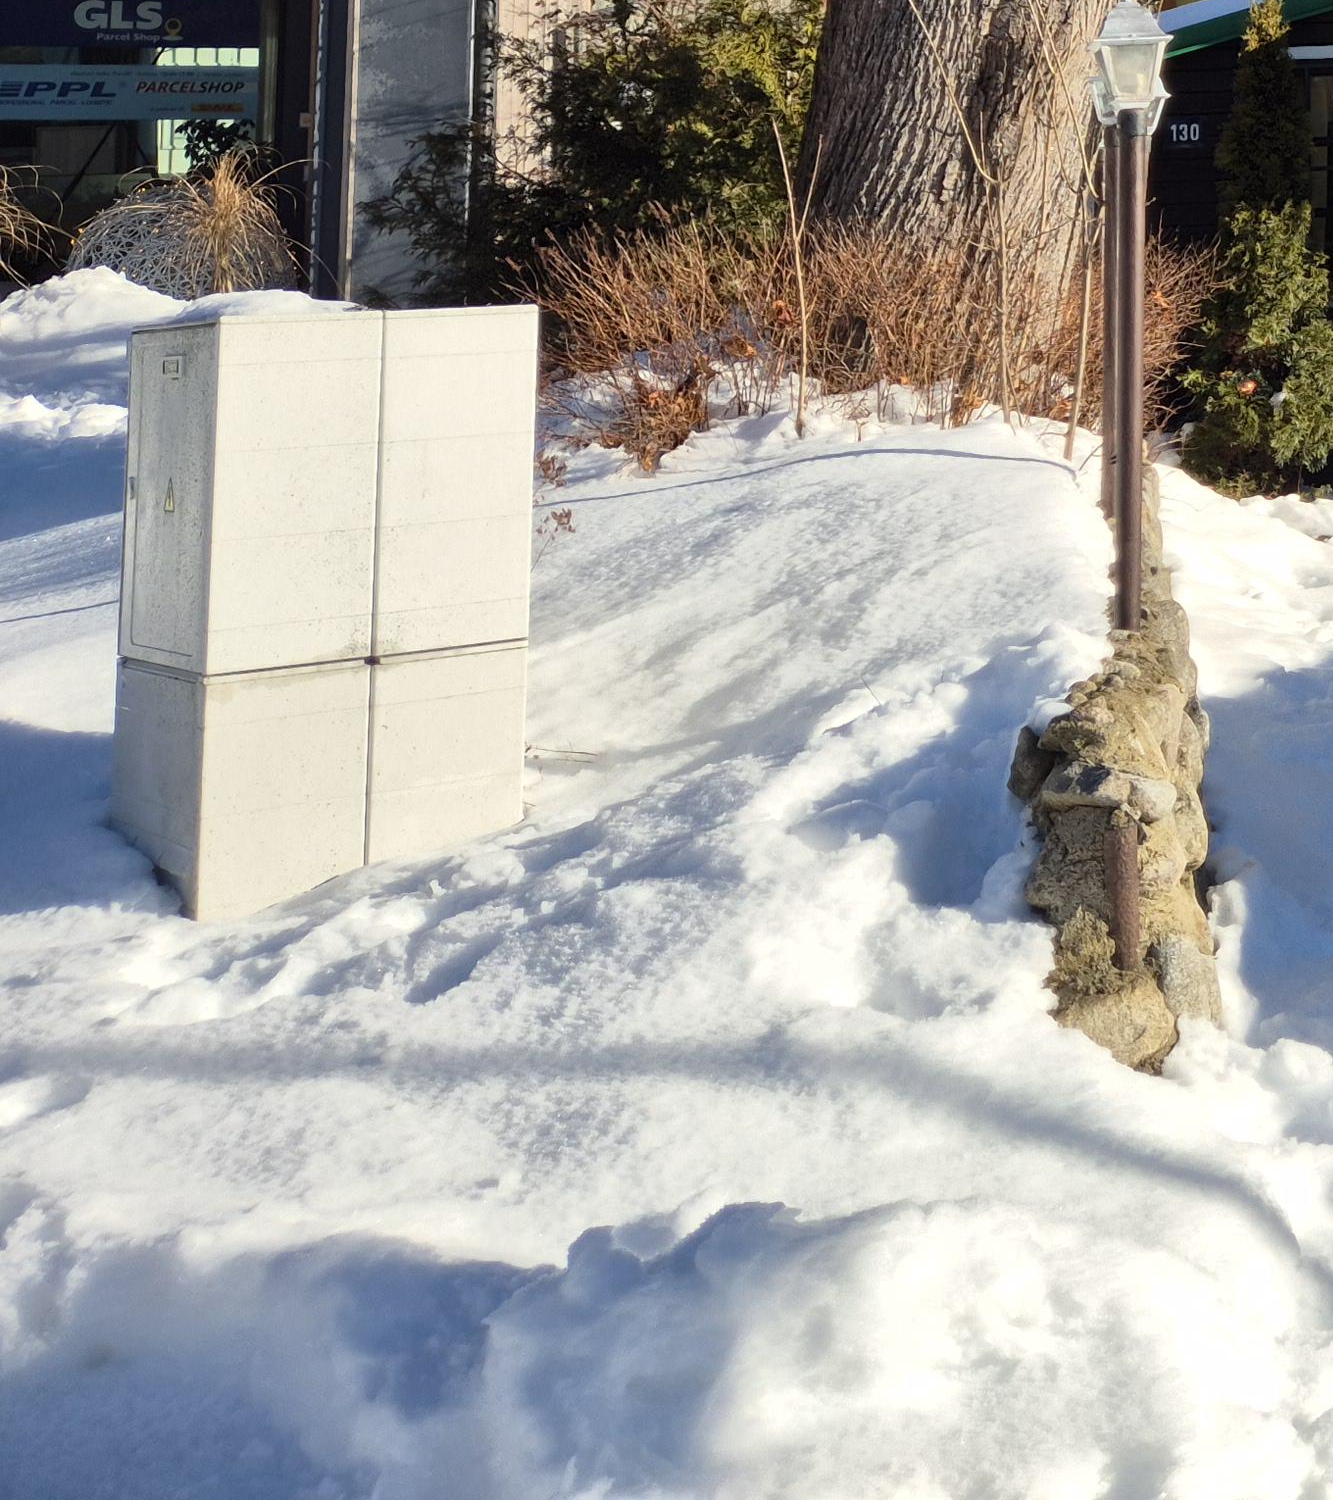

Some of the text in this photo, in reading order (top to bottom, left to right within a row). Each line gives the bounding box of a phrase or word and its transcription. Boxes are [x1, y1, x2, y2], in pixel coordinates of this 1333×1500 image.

[73, 0, 163, 31] GLS
[96, 32, 161, 44] Parcel Shop
[24, 81, 116, 98] PPL
[135, 81, 246, 94] PARCELSHOP
[1170, 123, 1200, 142] 130
